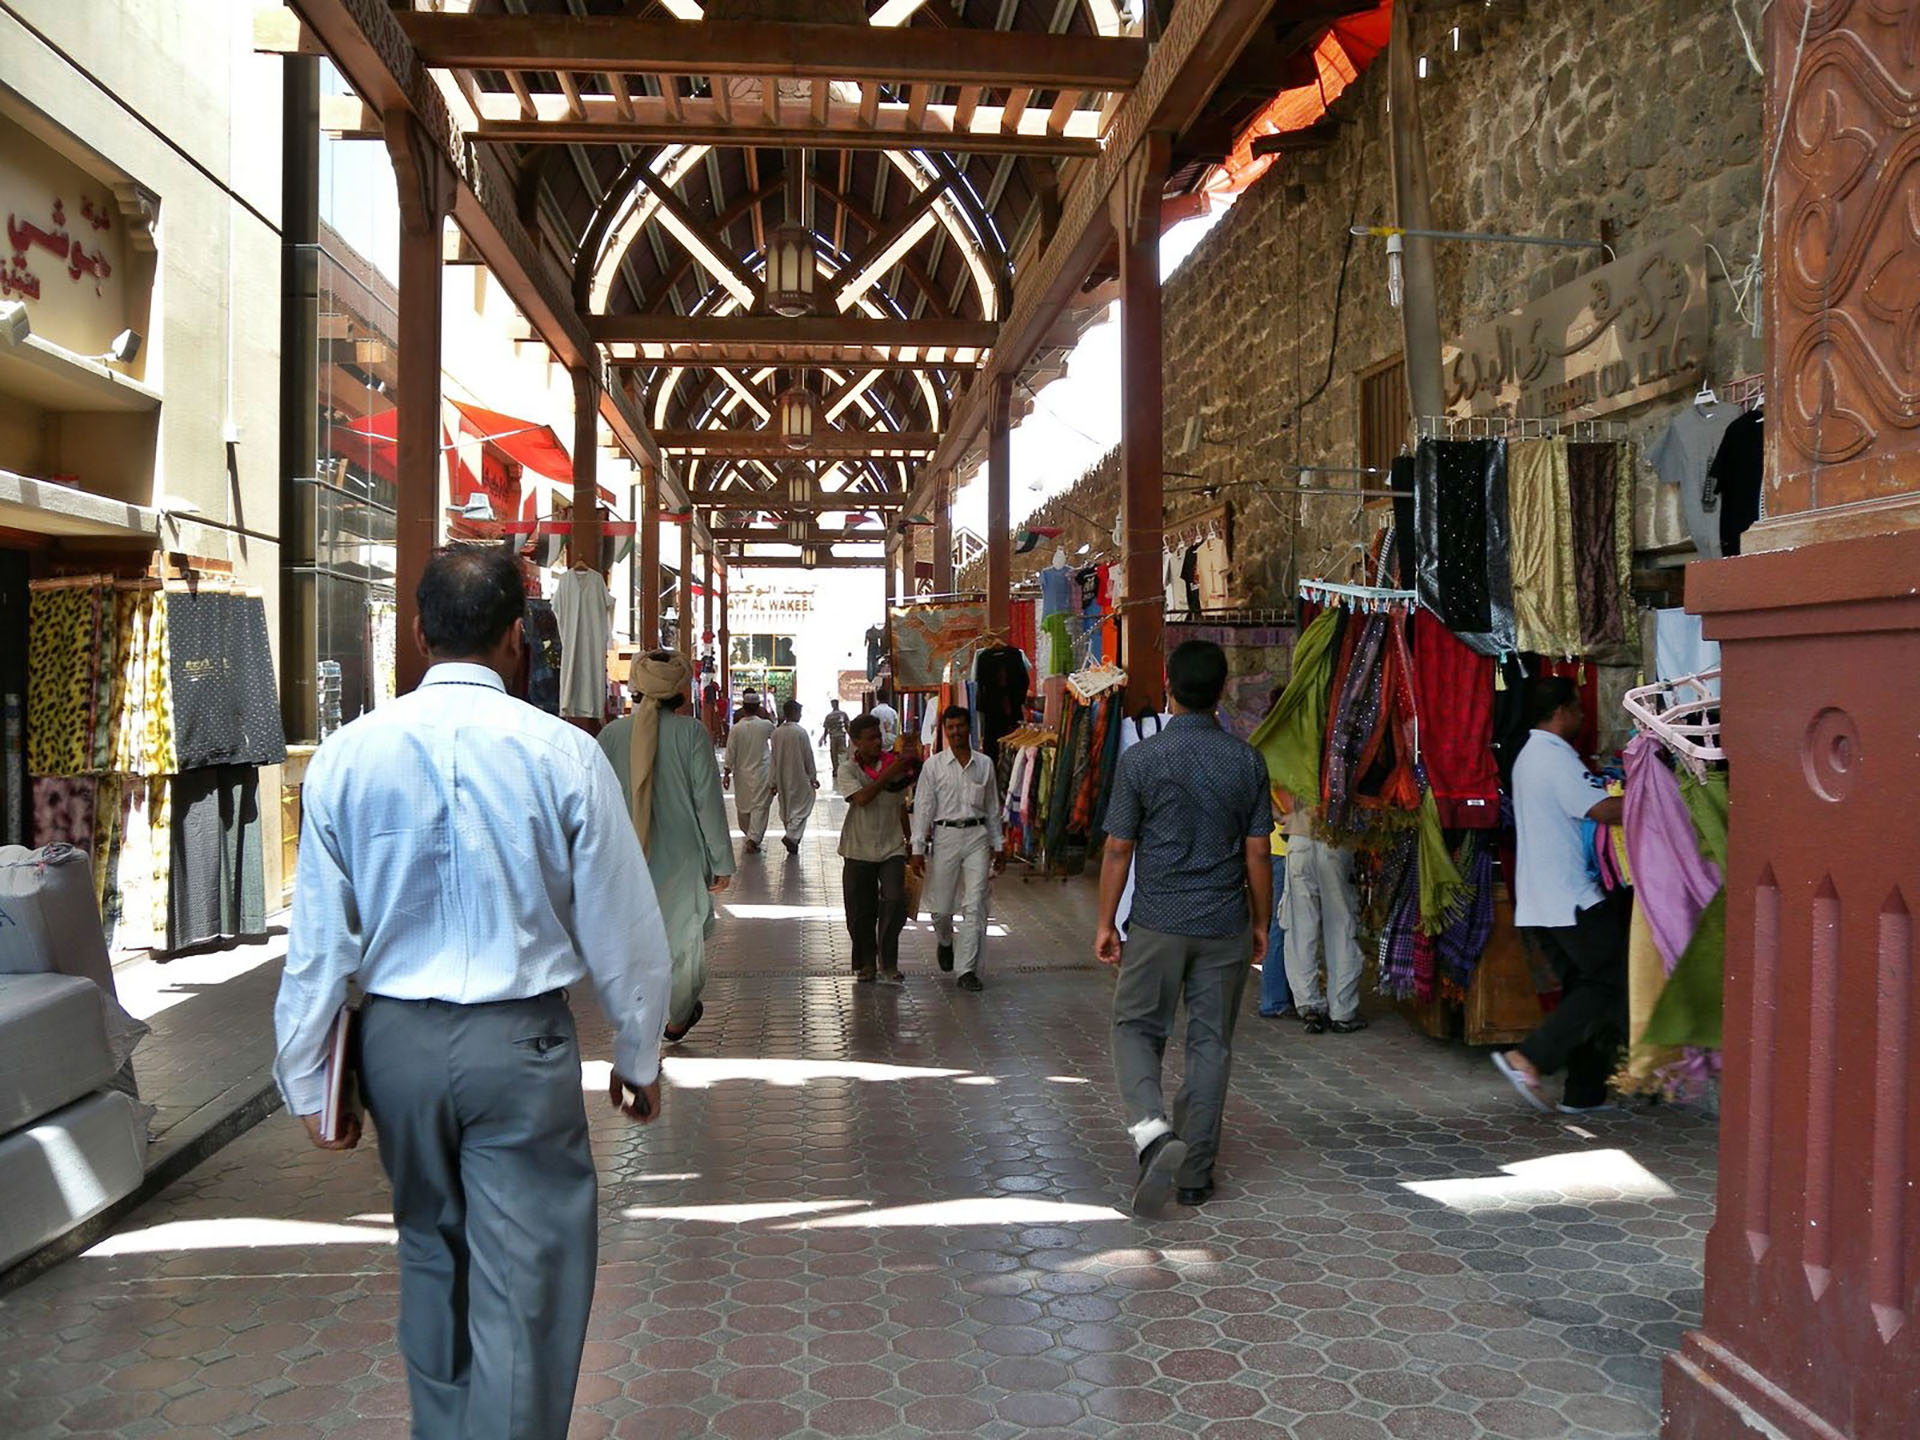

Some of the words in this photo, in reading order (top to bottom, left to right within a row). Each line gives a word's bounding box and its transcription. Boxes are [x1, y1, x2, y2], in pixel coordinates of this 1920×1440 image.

[784, 585, 815, 598] بيت
[727, 599, 748, 611] AYT
[752, 599, 765, 611] AL
[769, 599, 815, 611] WAKEEL
